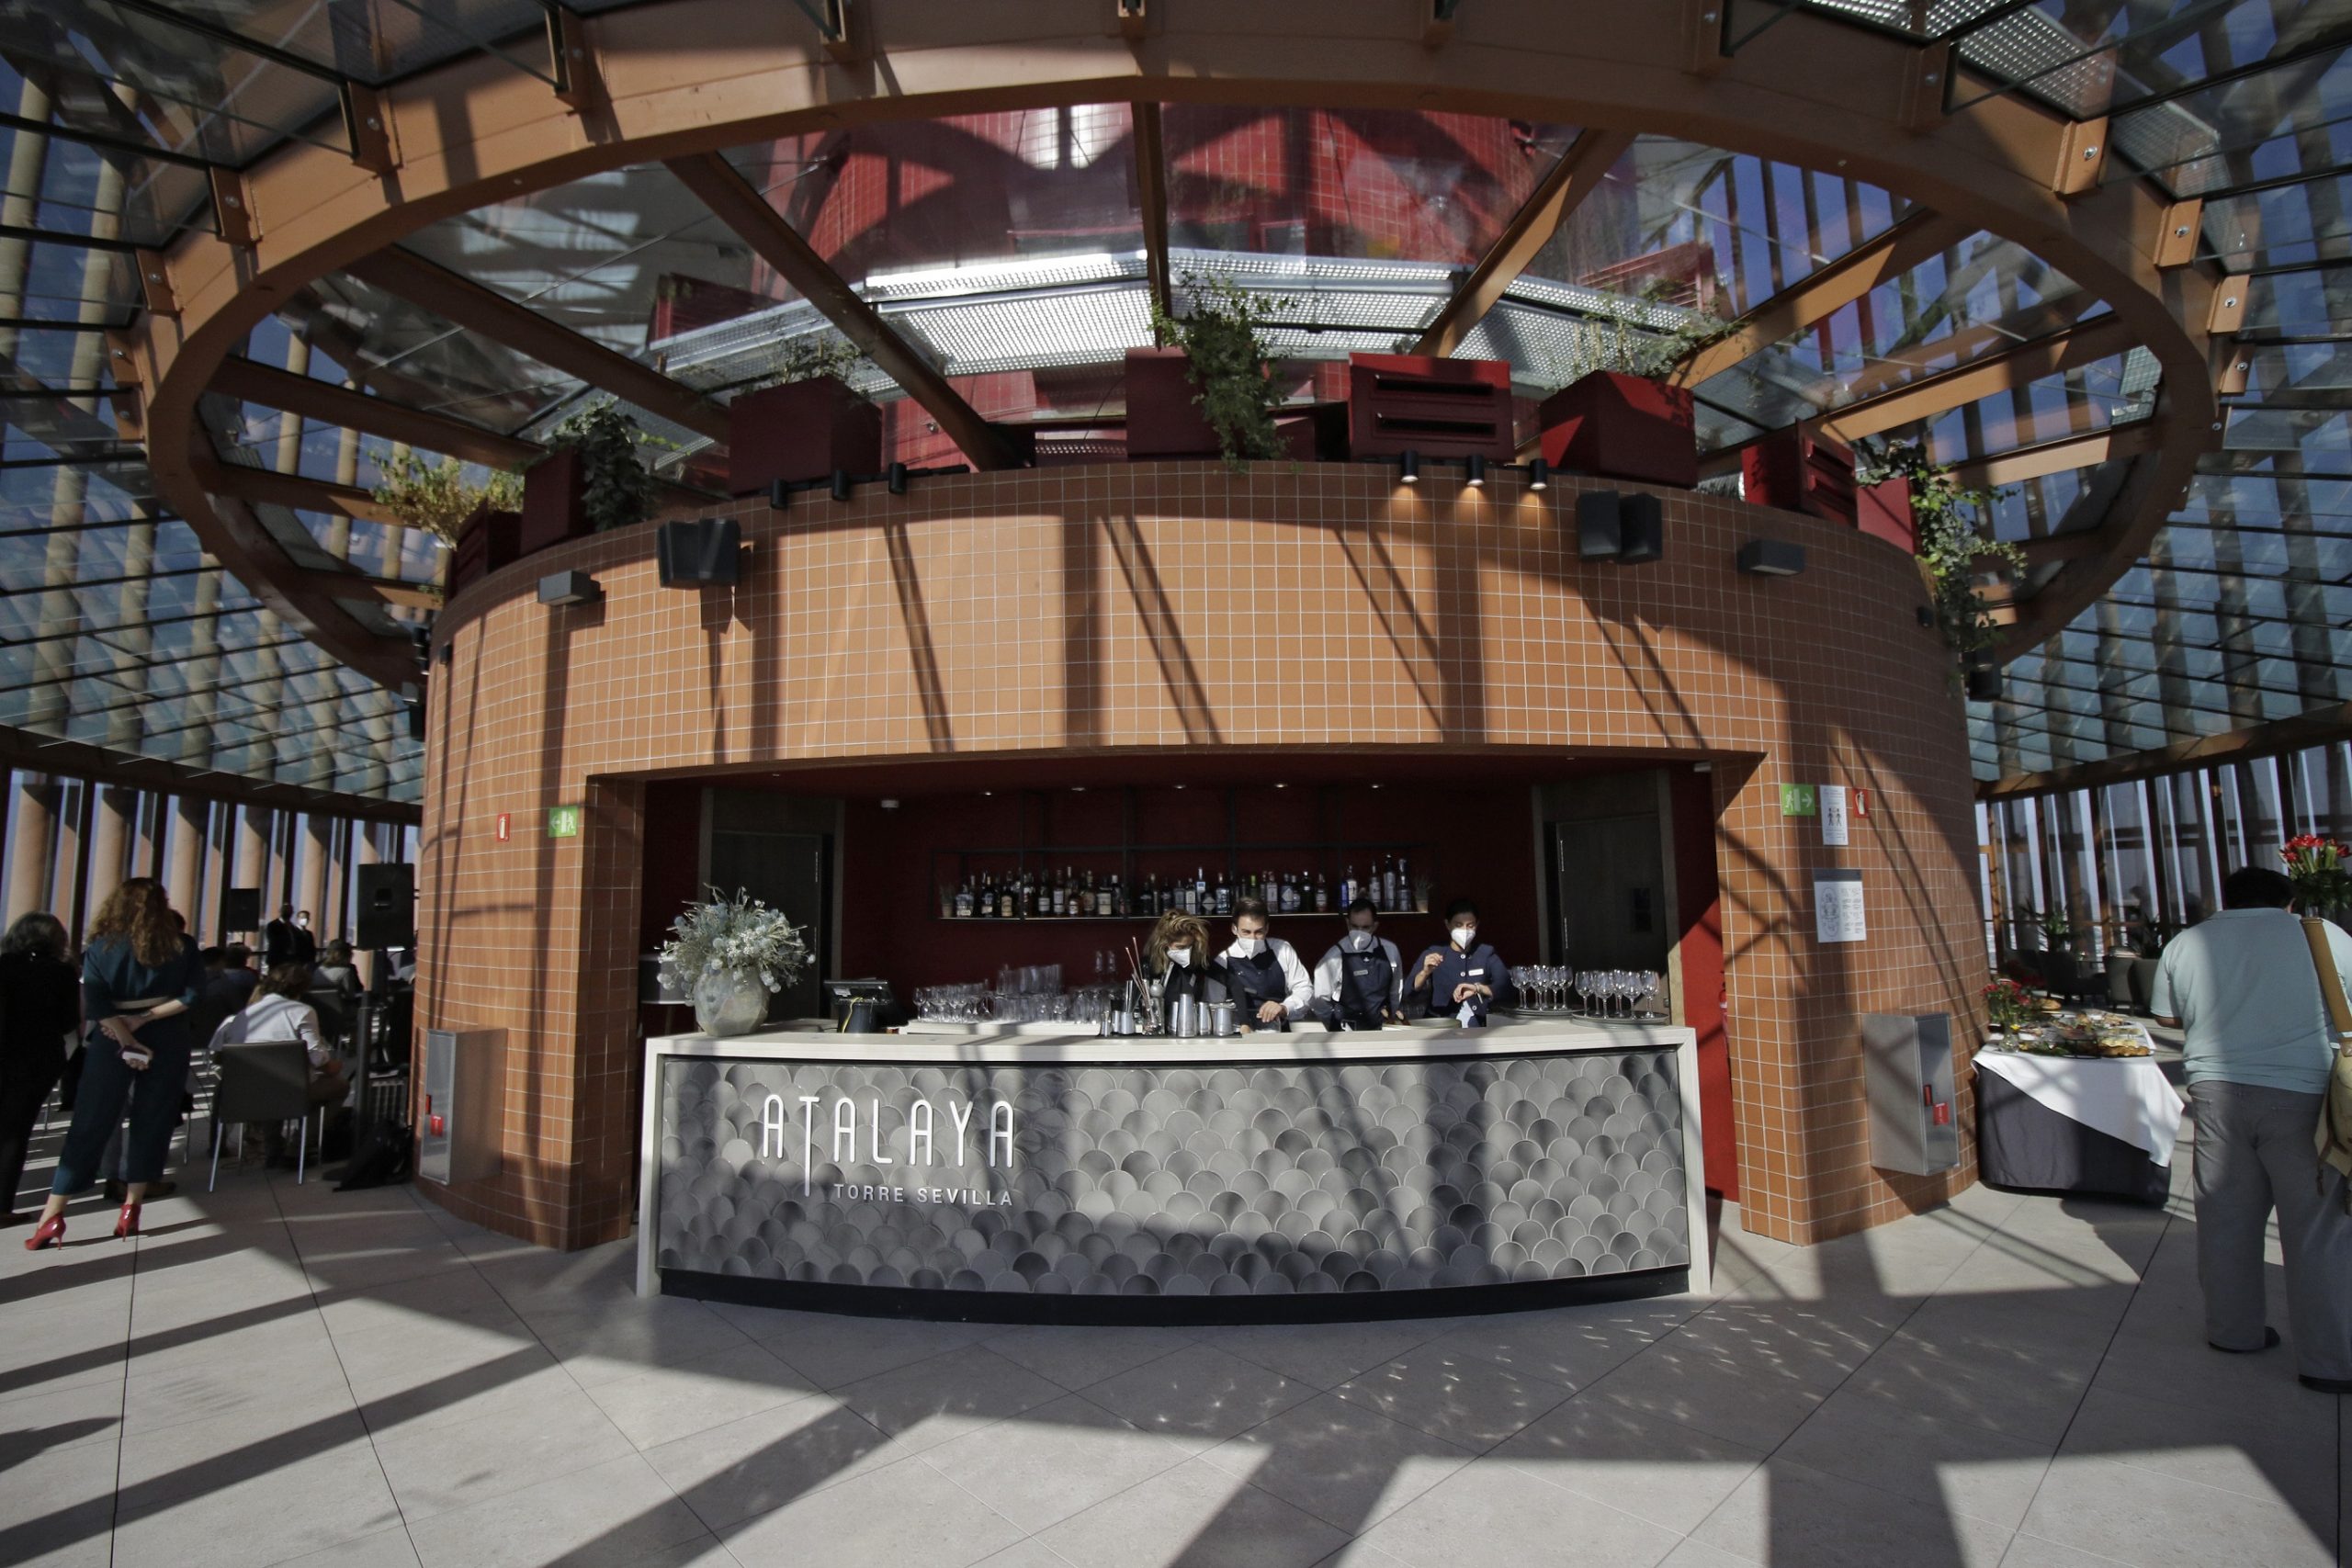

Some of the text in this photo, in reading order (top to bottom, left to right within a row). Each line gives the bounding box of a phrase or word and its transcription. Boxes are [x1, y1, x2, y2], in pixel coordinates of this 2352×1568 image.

[763, 1093, 1014, 1197] ATALAYA
[833, 1183, 1013, 1207] TORRE SEVILLA
